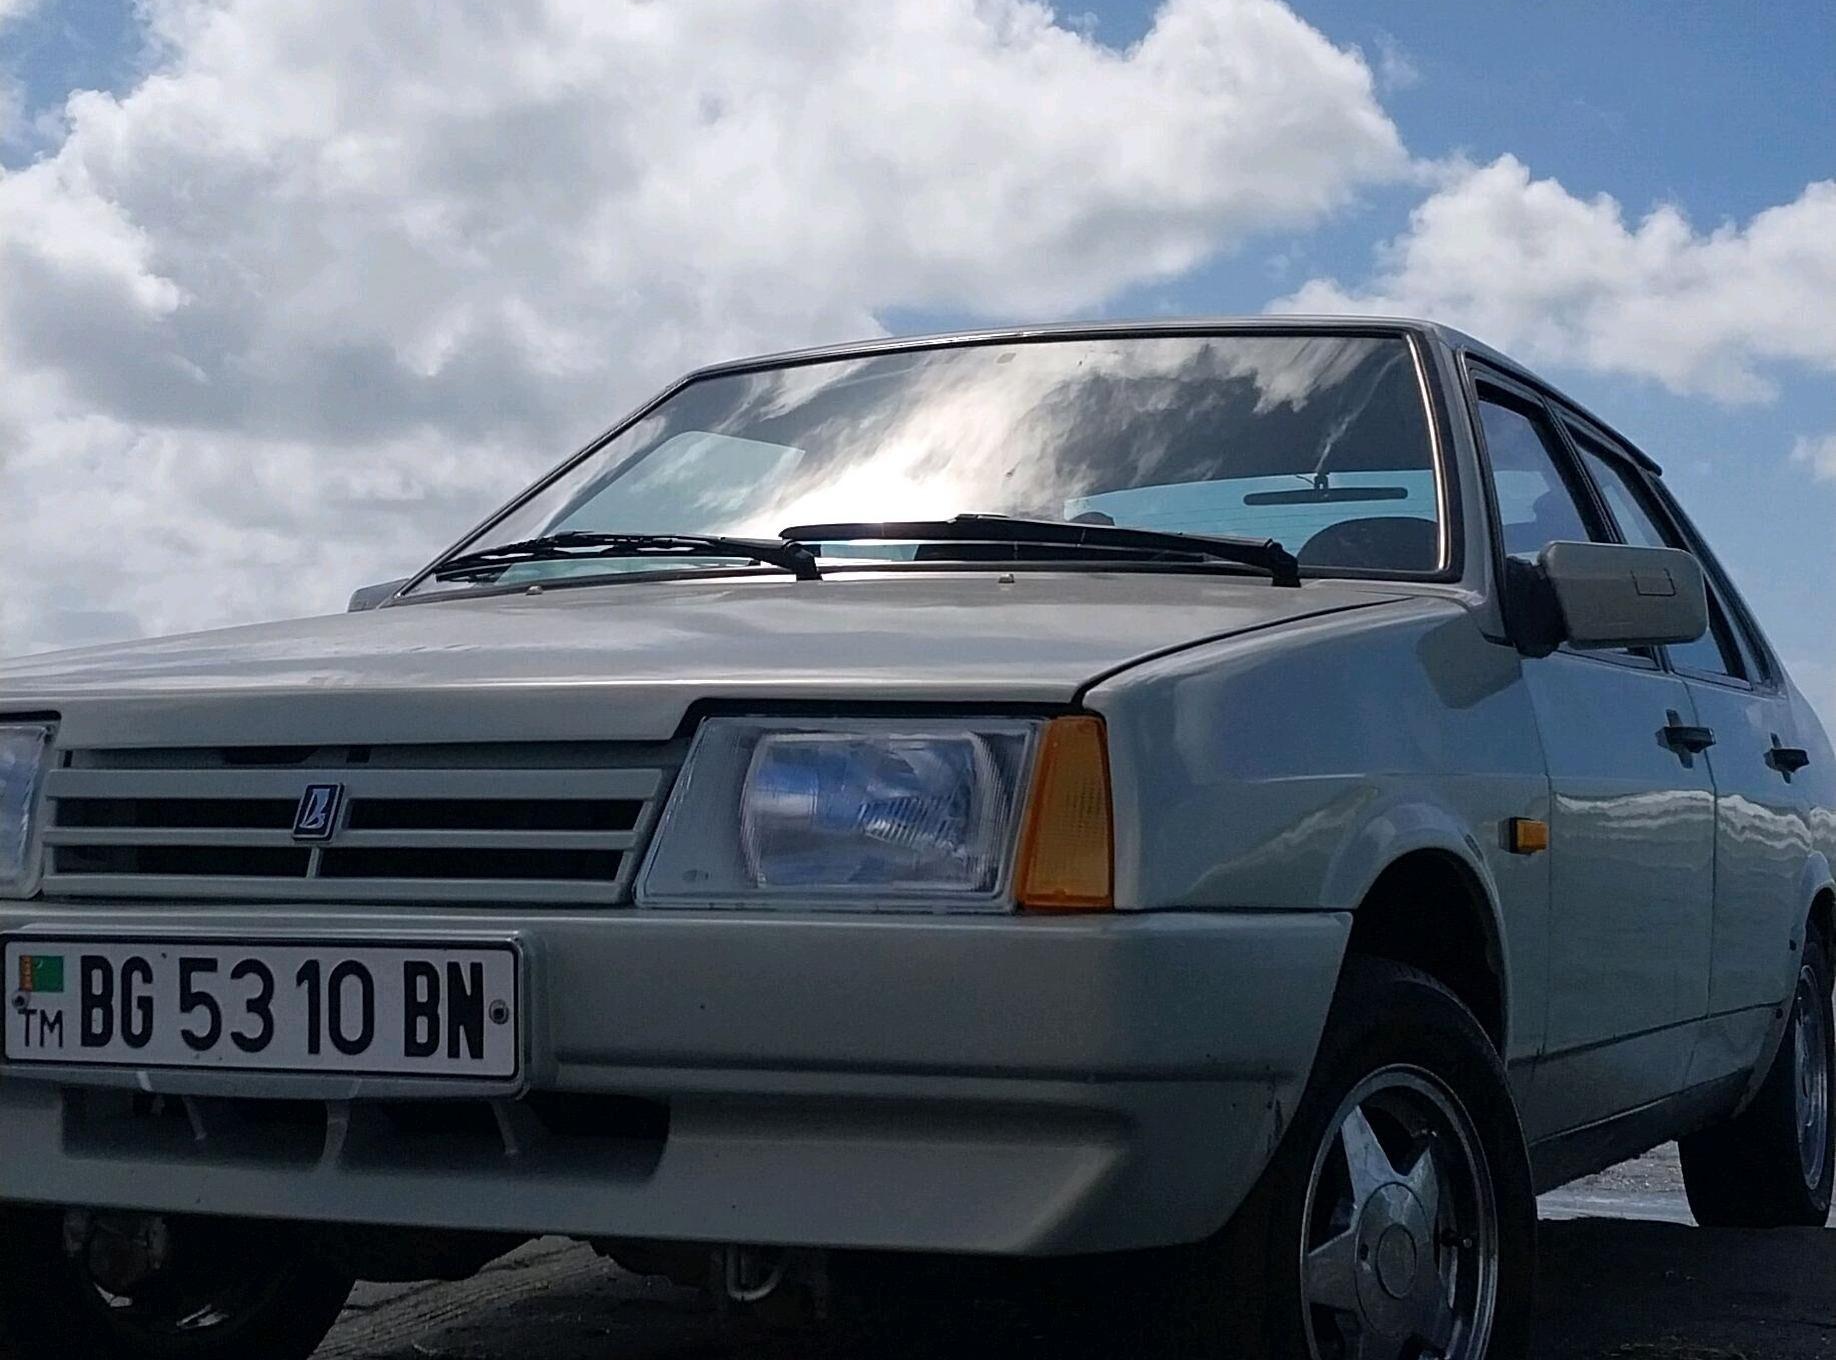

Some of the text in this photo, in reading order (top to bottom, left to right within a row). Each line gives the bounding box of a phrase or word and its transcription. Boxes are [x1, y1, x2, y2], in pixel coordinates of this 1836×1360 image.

[18, 1007, 64, 1048] TM
[80, 955, 485, 1059] BG 53 10 BN
